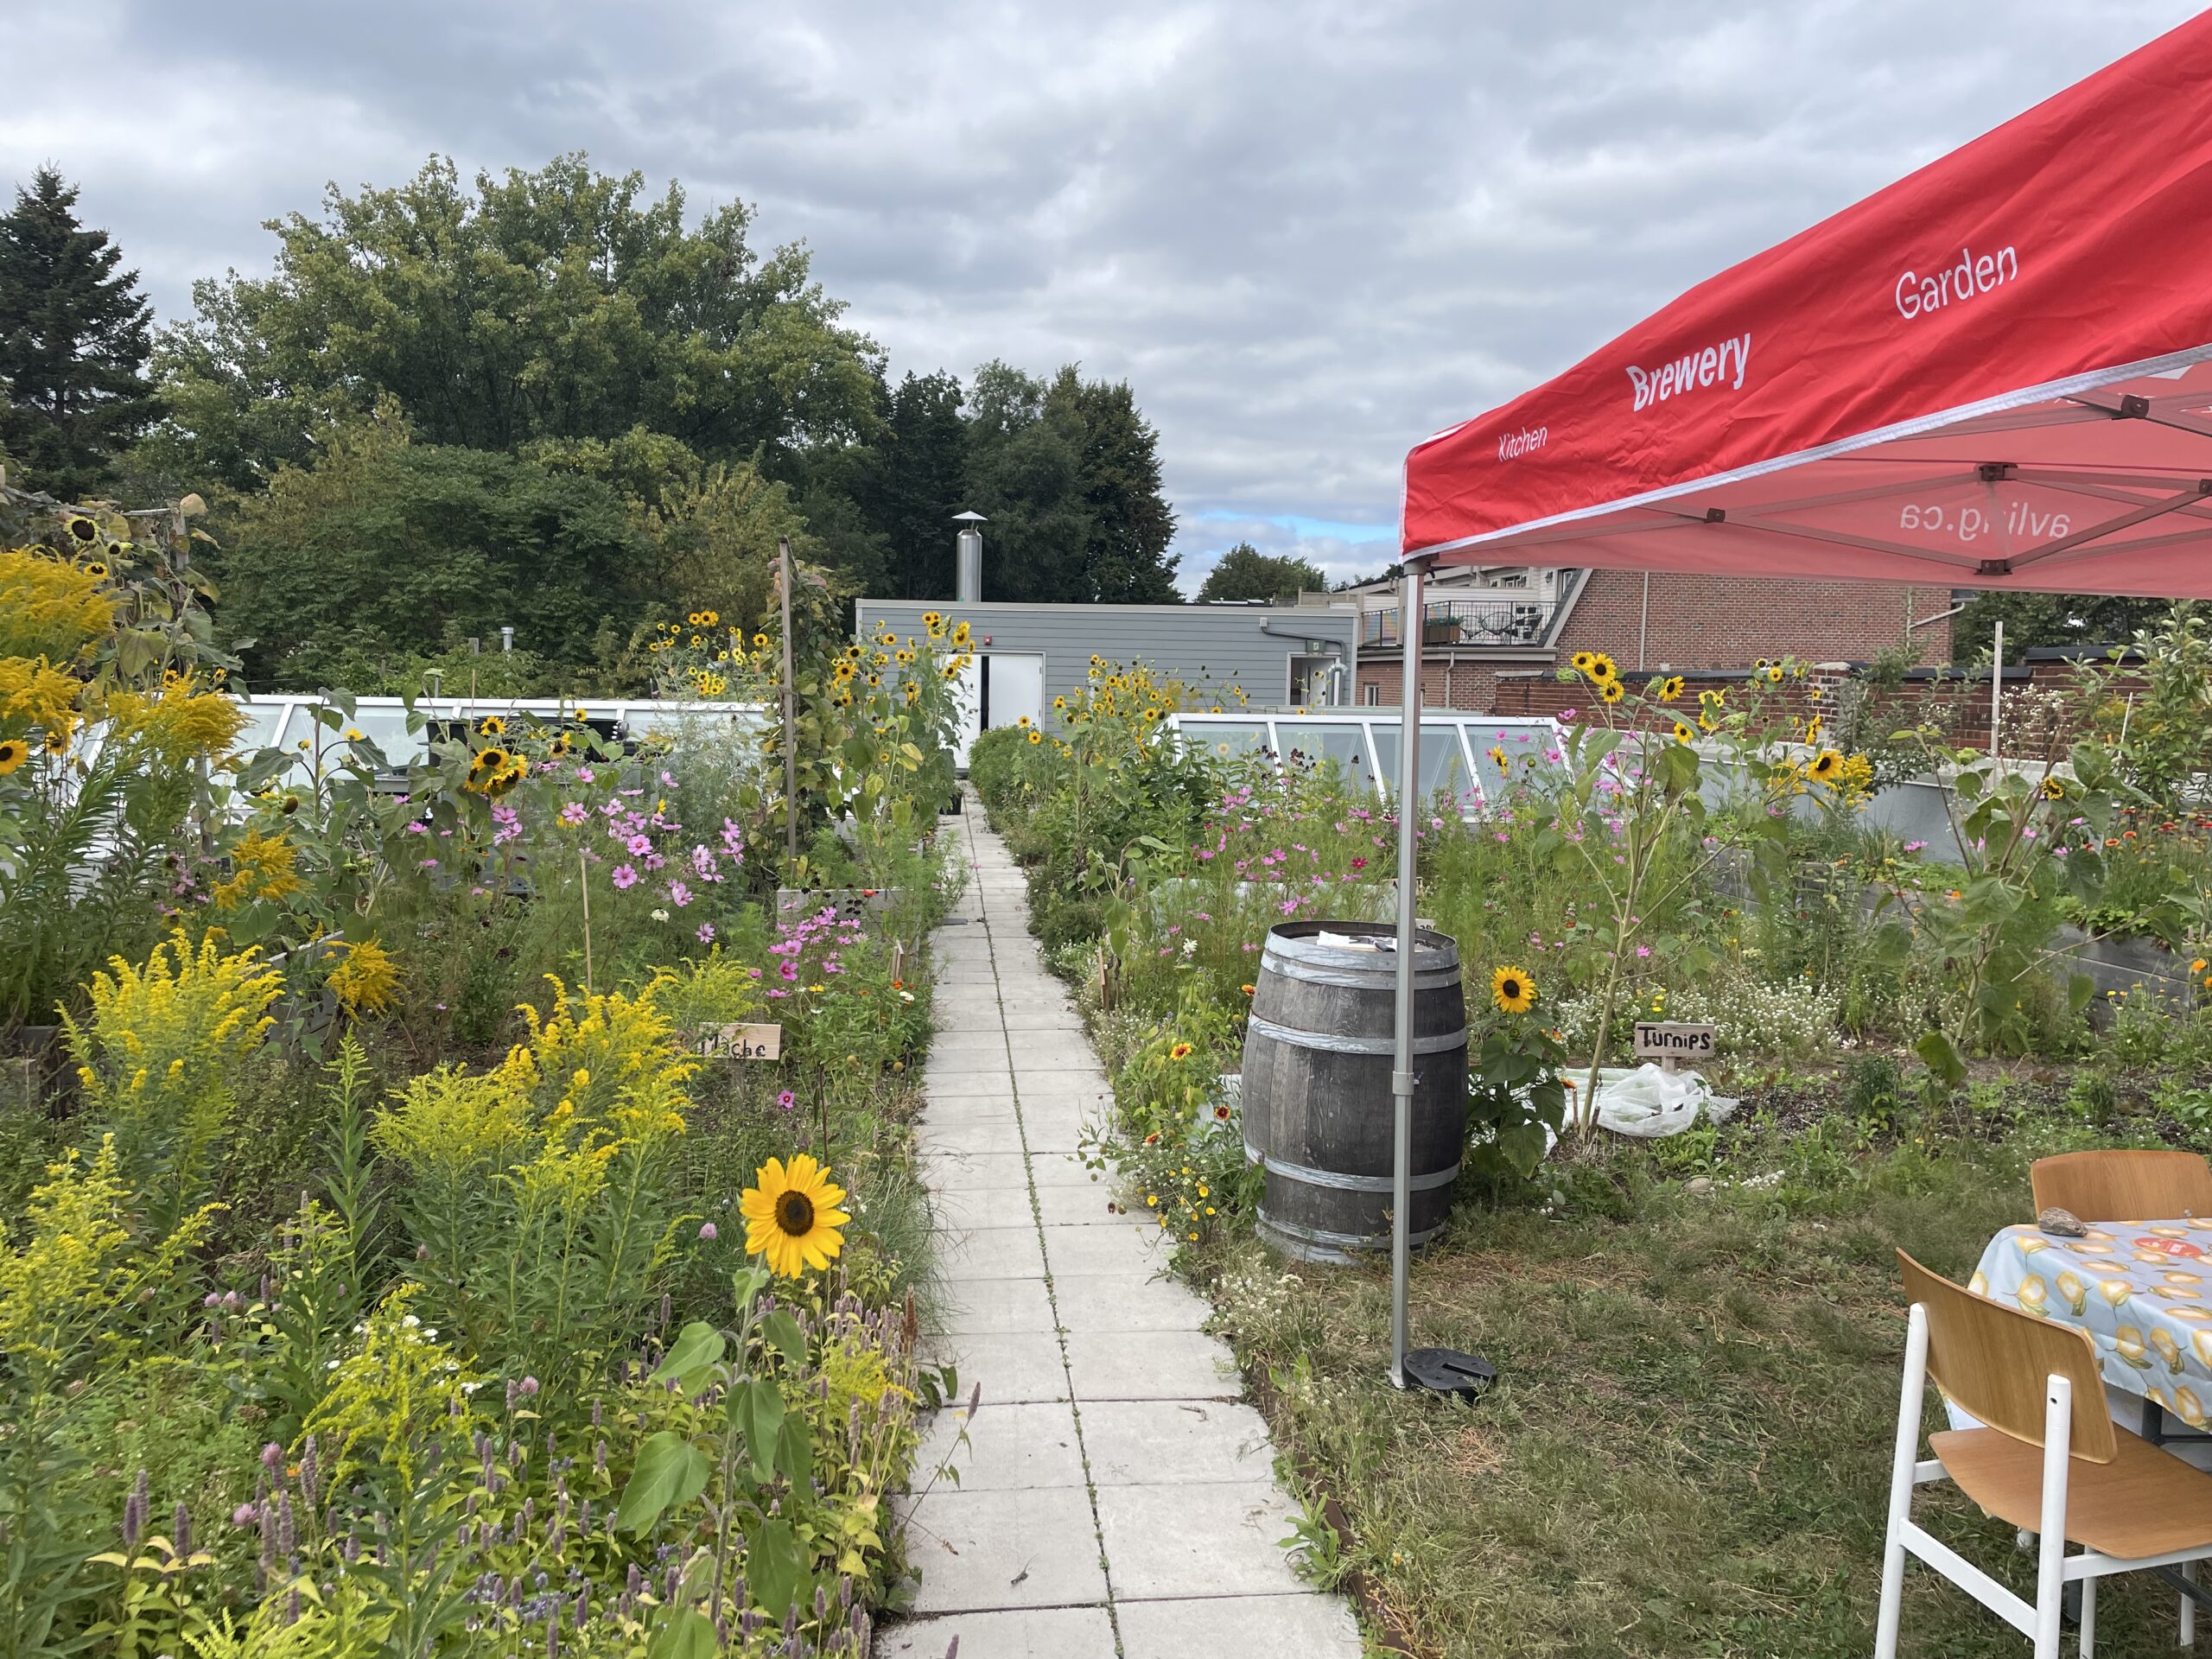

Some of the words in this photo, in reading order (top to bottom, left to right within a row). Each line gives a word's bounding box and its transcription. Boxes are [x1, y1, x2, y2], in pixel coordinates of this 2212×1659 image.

[1895, 245, 2018, 320] Garden
[1625, 333, 1751, 412] Brewery
[1497, 426, 1548, 462] Kitchen
[1637, 1026, 1712, 1051] Turnips
